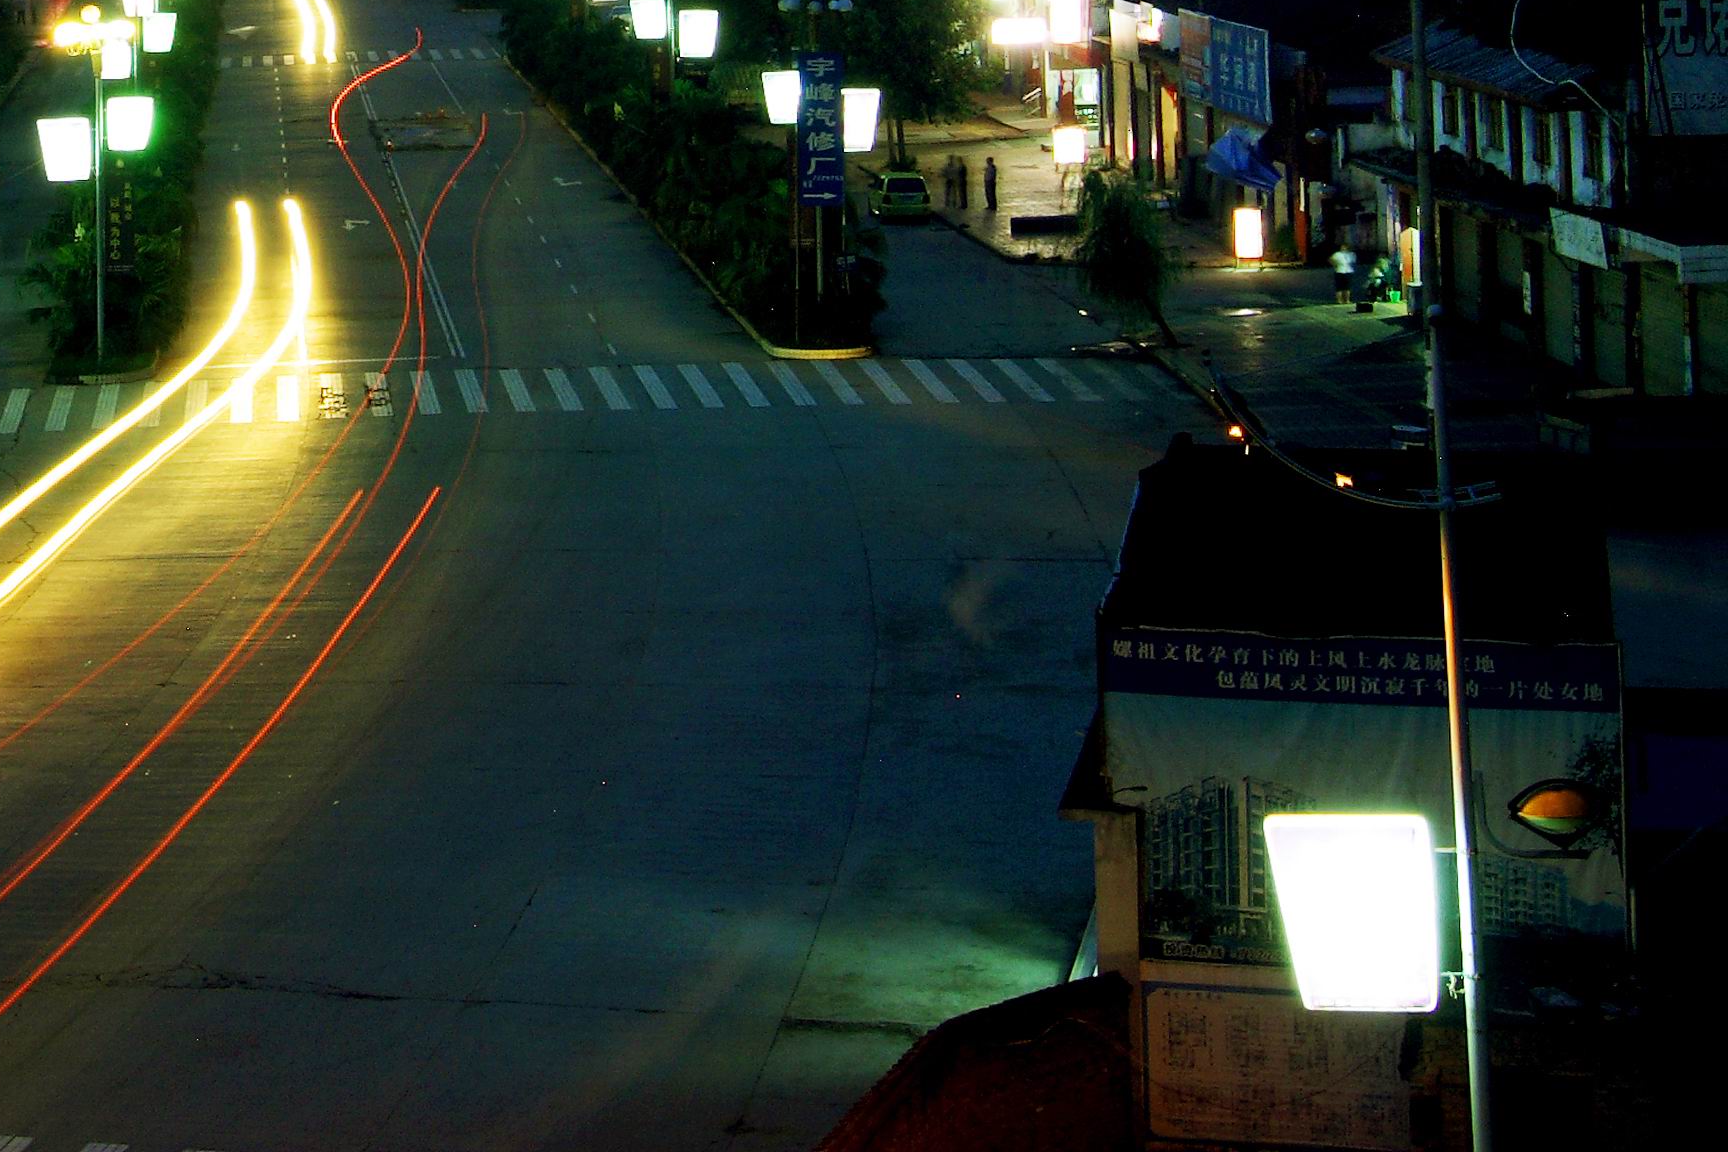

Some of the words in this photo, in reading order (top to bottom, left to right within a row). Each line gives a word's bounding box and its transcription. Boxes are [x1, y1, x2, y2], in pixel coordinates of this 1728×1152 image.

[805, 57, 836, 175] 宇峰汽修厂
[1111, 639, 1495, 673] 嫘祖文化孕育下的上风上水龙脉地
